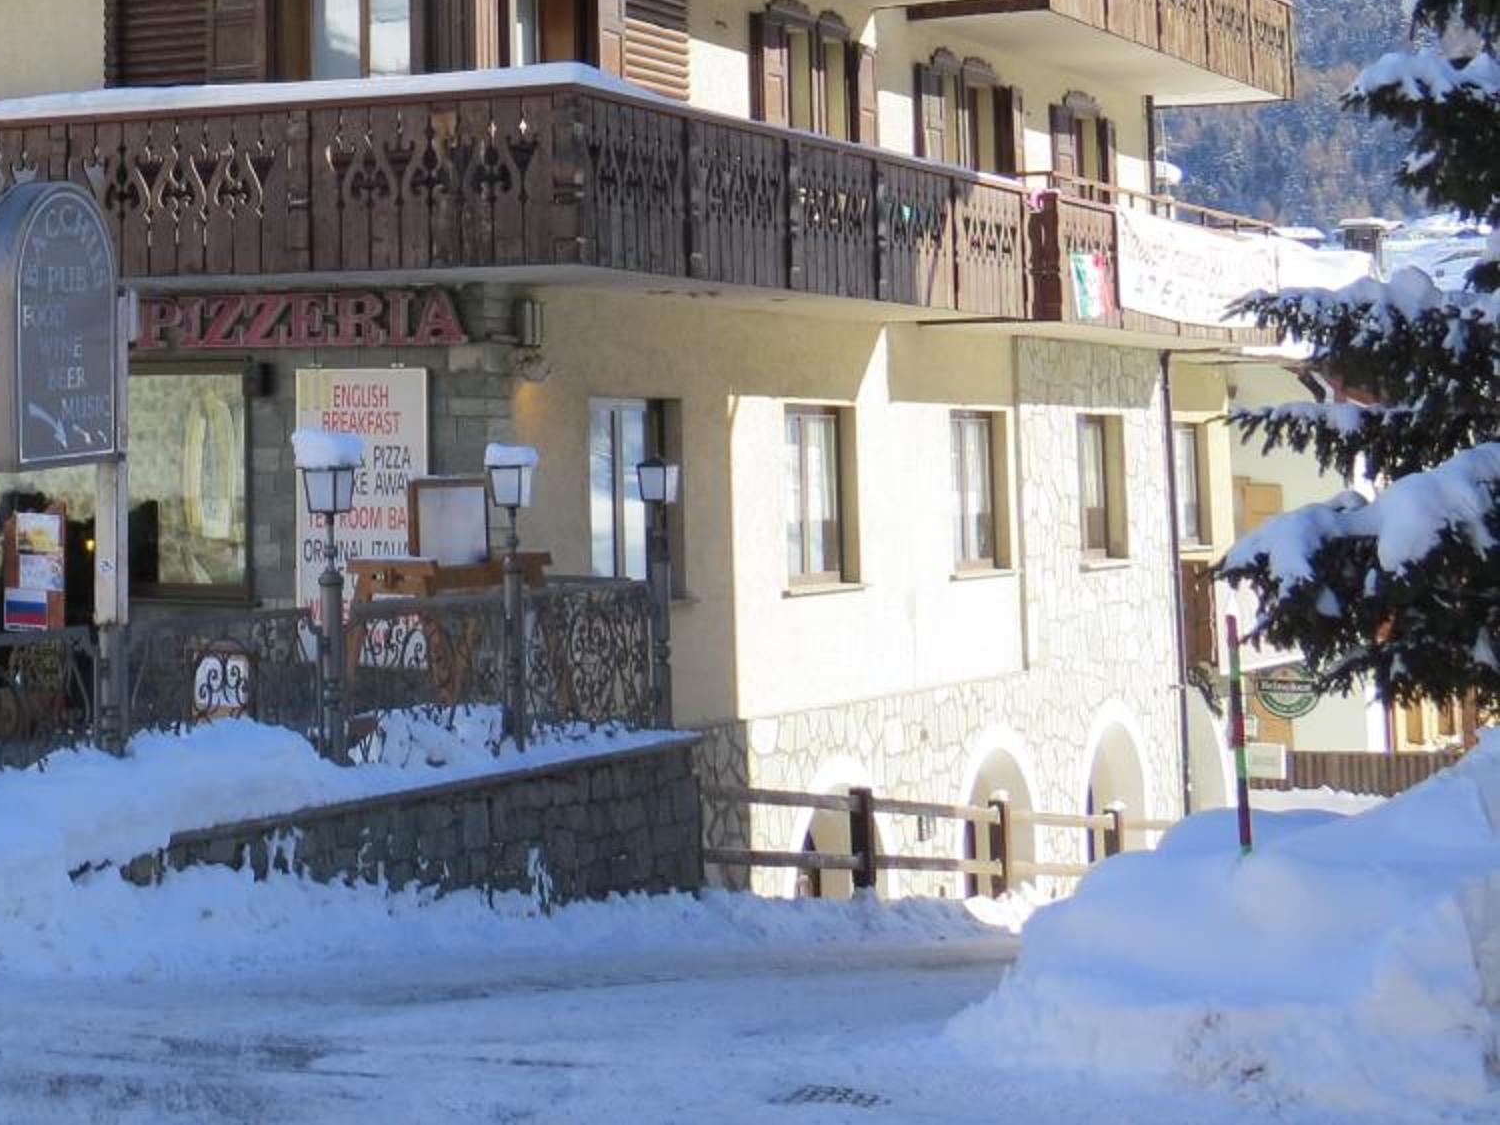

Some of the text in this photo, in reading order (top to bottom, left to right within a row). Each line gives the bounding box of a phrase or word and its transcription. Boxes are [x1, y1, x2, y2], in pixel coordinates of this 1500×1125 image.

[47, 266, 87, 293] PUB
[22, 304, 66, 329] FOOD
[137, 288, 468, 347] PIZZERIA
[47, 366, 88, 391] BEER
[333, 384, 389, 409] ENGLISH
[322, 411, 402, 436] BREAKFAST
[373, 445, 412, 469] PIZZA
[340, 507, 382, 530] ROOM
[388, 507, 407, 530] BA
